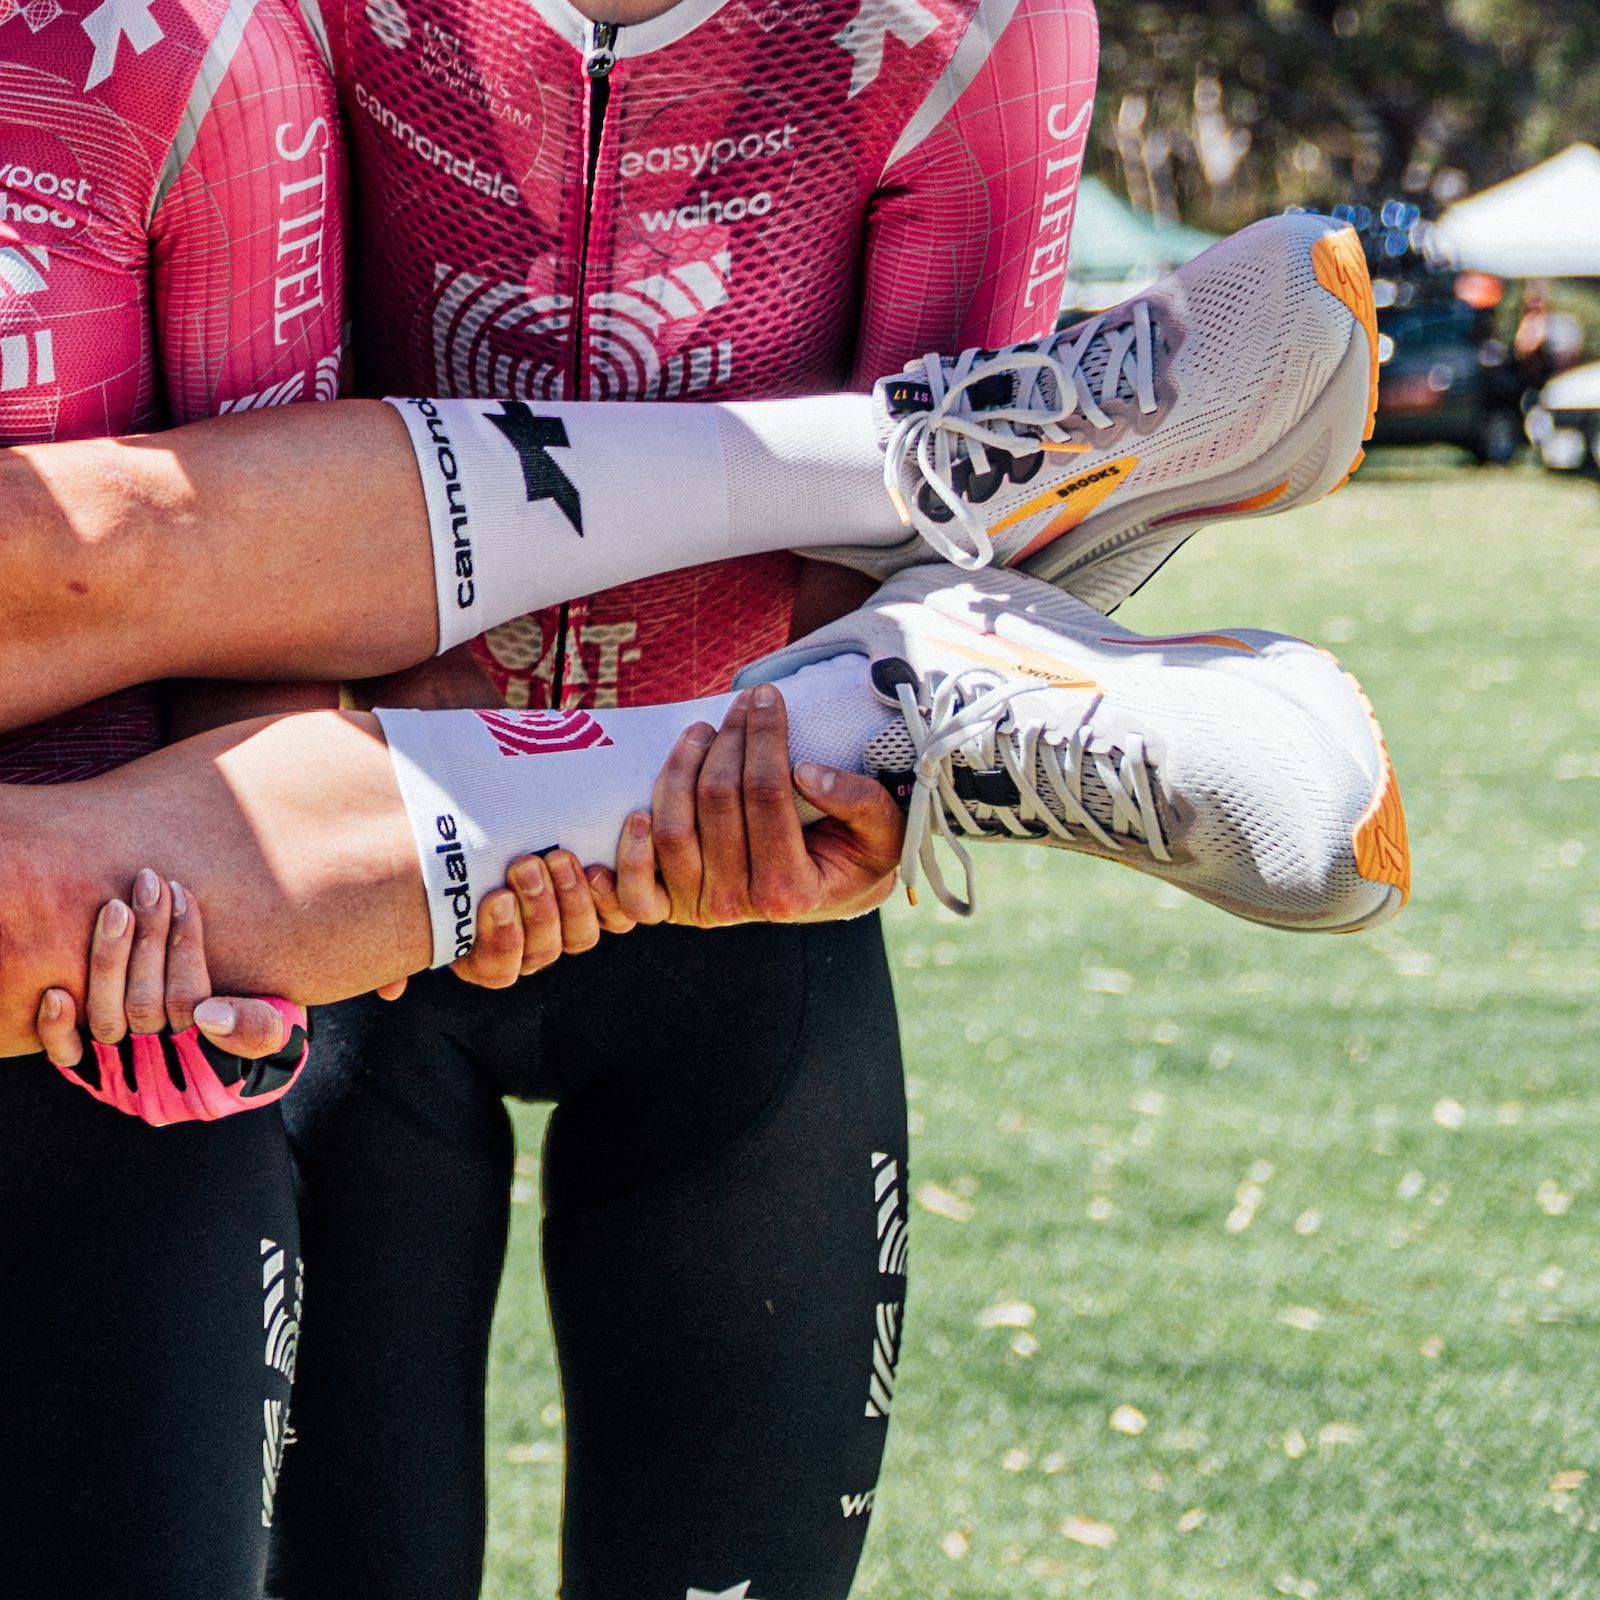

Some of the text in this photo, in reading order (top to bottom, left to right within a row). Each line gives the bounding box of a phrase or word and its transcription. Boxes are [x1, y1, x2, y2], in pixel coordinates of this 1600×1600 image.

[355, 84, 519, 206] cannondale
[620, 123, 797, 177] easypost
[274, 117, 329, 345] STIFEL
[639, 190, 771, 232] wahoo
[1024, 98, 1094, 308] STIFEL
[1057, 466, 1120, 498] BROOKS
